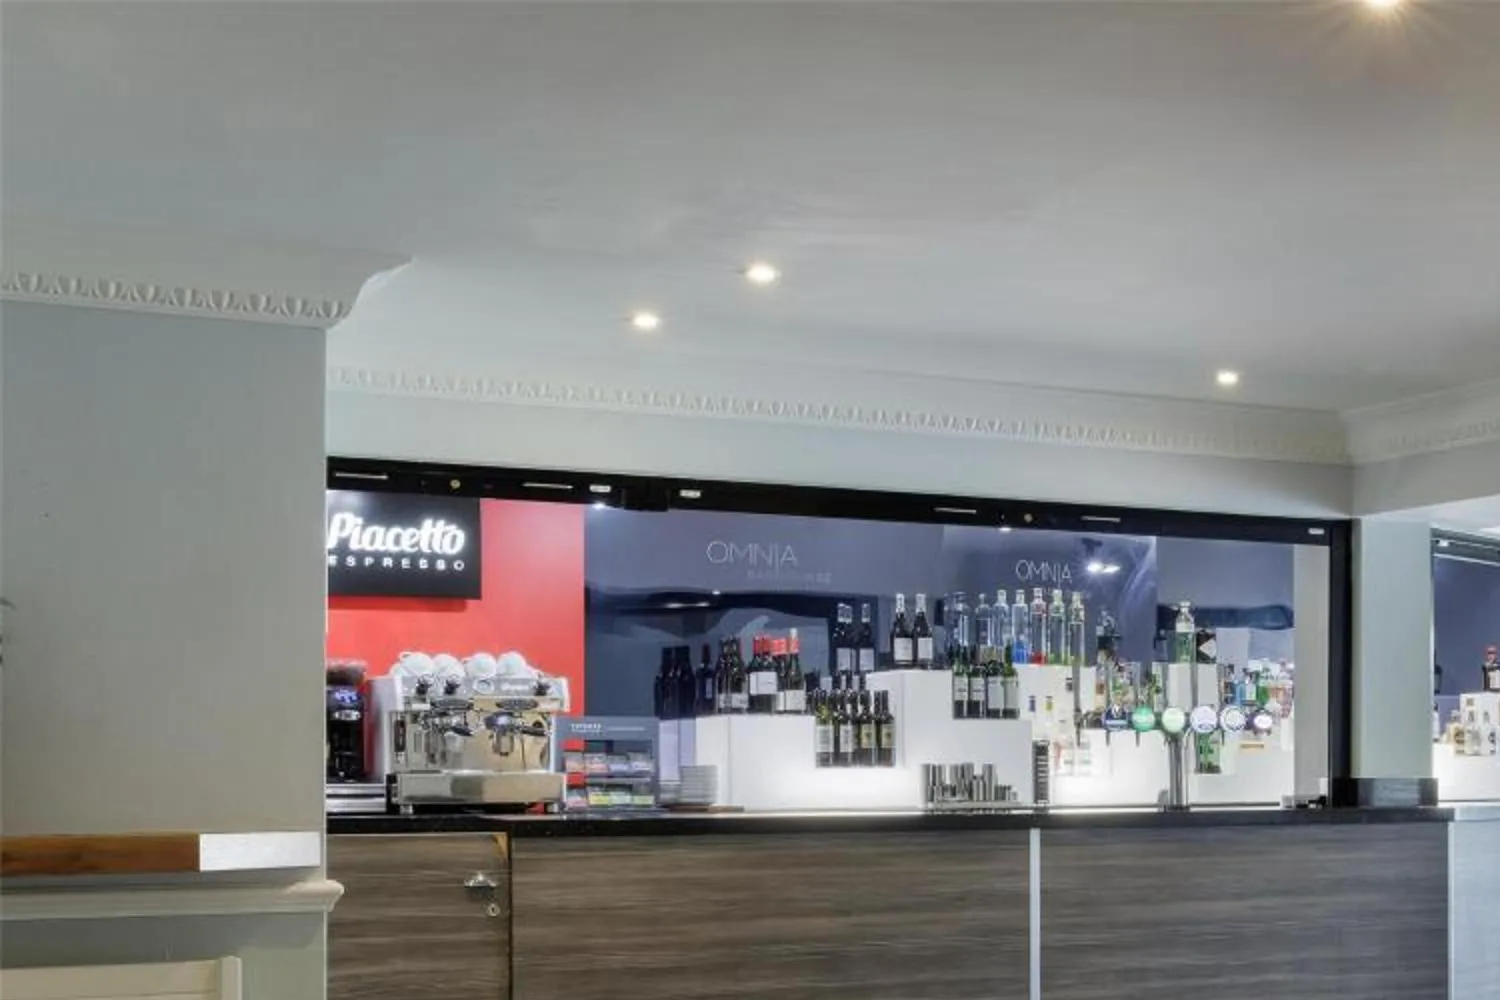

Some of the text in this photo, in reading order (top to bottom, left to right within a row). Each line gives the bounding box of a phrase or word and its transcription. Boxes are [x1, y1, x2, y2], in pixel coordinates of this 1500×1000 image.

[326, 511, 465, 555] Piacetto
[327, 554, 465, 571] ESPRESSO
[706, 540, 799, 578] OMNIA
[1015, 559, 1073, 588] OMNIA
